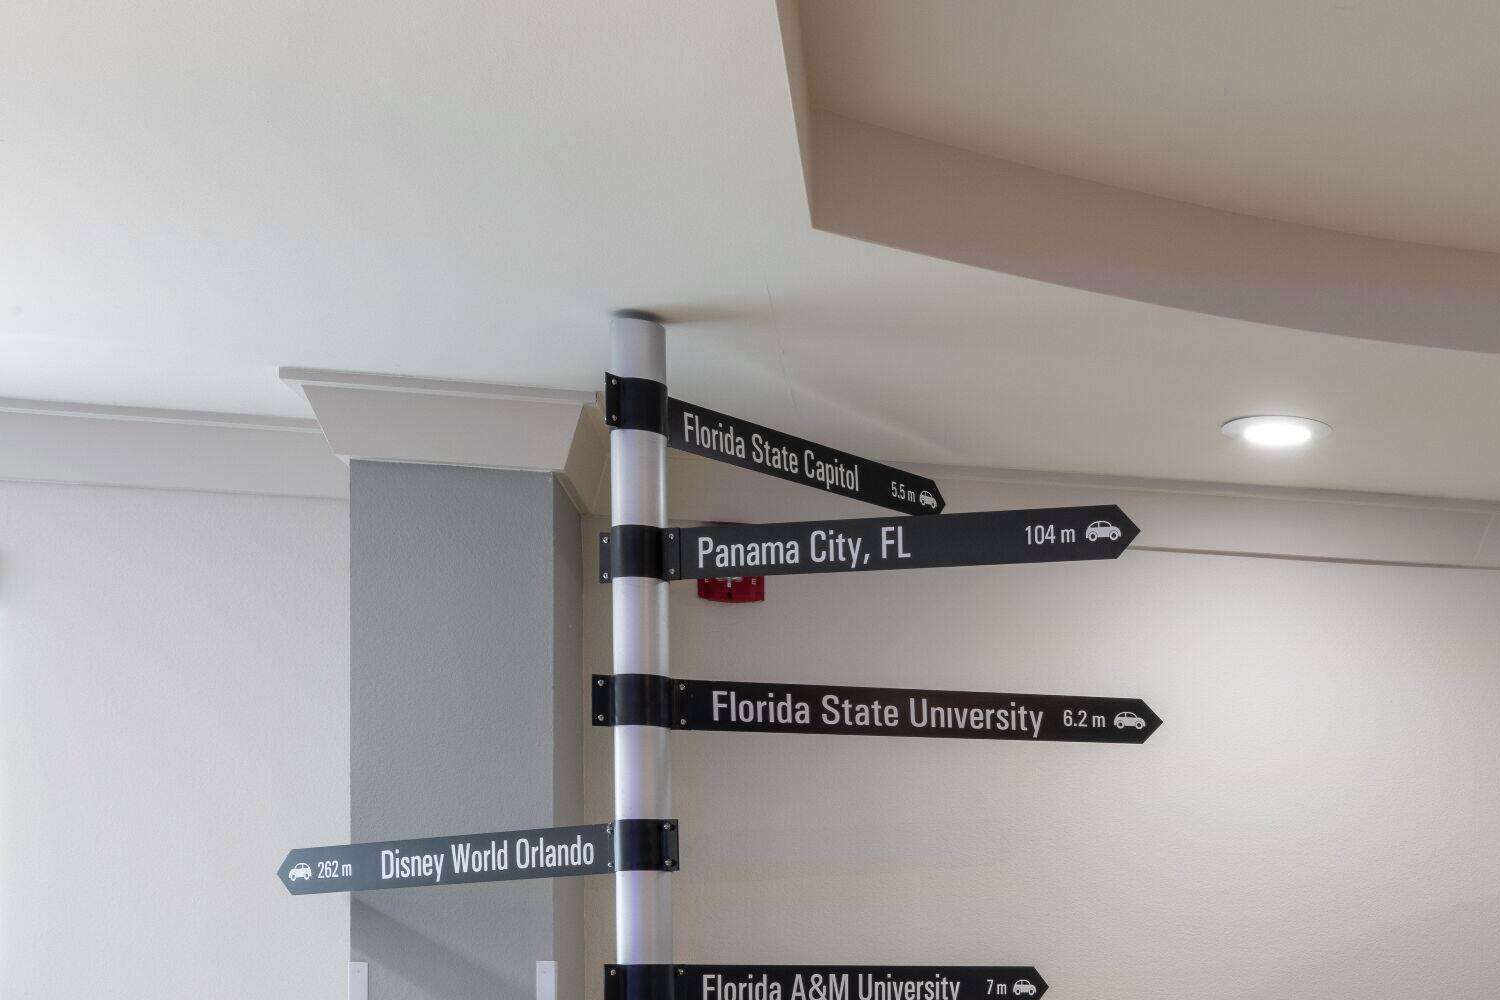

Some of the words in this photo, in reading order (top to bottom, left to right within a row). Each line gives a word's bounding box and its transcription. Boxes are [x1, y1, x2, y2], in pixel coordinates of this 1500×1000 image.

[683, 411, 746, 460] Florida
[750, 433, 799, 475] State
[803, 448, 860, 493] Capitol
[891, 480, 906, 500] 5.5
[907, 490, 916, 503] m
[698, 536, 800, 569] Panama
[810, 529, 871, 569] City,
[881, 525, 912, 559] FL
[1025, 524, 1056, 545] 104
[1060, 528, 1076, 544] m
[712, 690, 811, 724] Florida
[821, 694, 899, 727] State
[908, 697, 1044, 739] University
[1063, 709, 1088, 728] 6.2
[1091, 715, 1106, 728] m
[317, 860, 339, 879] 262
[341, 863, 352, 877] m
[380, 848, 445, 883] Disney
[450, 839, 509, 874] World
[515, 834, 595, 869] Orlando
[986, 979, 994, 995] 7
[996, 983, 1007, 995] m
